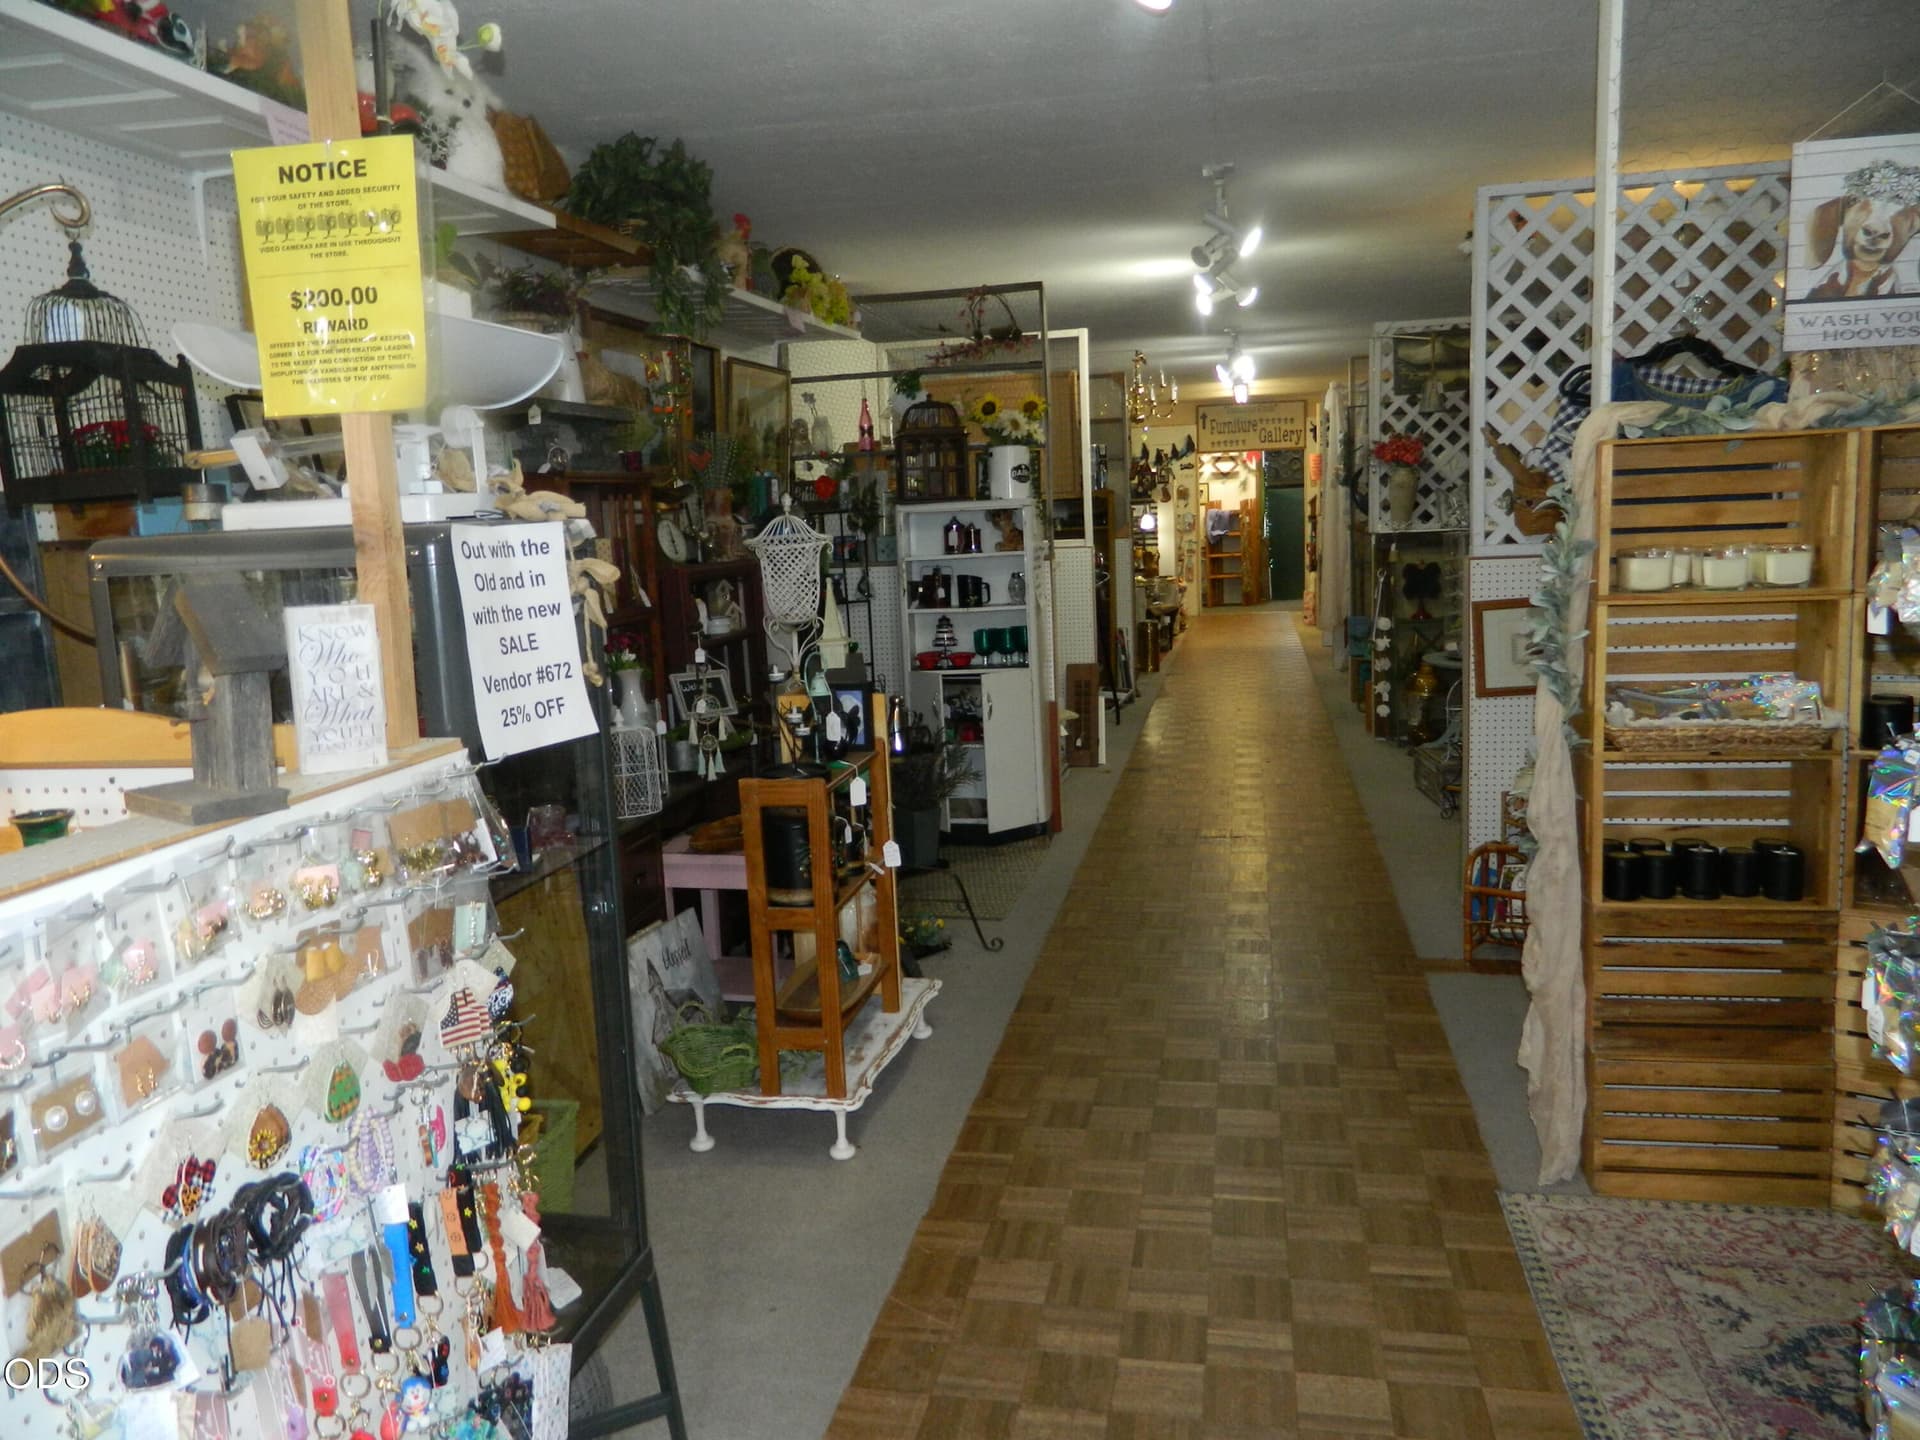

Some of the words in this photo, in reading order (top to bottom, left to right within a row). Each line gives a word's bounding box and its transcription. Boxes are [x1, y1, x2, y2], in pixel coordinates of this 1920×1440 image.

[278, 158, 368, 184] NOTICE
[267, 193, 287, 202] YOUR
[289, 191, 316, 200] SAFETY
[318, 189, 334, 197] AND
[336, 187, 361, 195] ADDED
[363, 184, 401, 193] SECURITY
[310, 201, 324, 209] THE
[282, 243, 313, 251] CAMERAS
[289, 286, 378, 310] $200.00
[1799, 312, 1871, 328] WASH
[1822, 326, 1920, 342] HOOVES
[1209, 418, 1258, 435] Furniture
[1258, 427, 1303, 446] Gallery
[461, 541, 486, 560] Out
[488, 540, 515, 559] with
[521, 539, 550, 557] the
[473, 573, 496, 592] Old
[499, 572, 525, 590] and
[530, 571, 546, 588] in
[473, 606, 499, 625] with
[502, 604, 523, 622] the
[528, 602, 561, 619] new
[298, 623, 366, 642] KNOW
[499, 633, 539, 655] SALE
[308, 664, 370, 686] YOU
[483, 671, 532, 694] Vendor
[536, 662, 573, 684] #672
[501, 704, 531, 728] 25%
[534, 697, 566, 721] OFF
